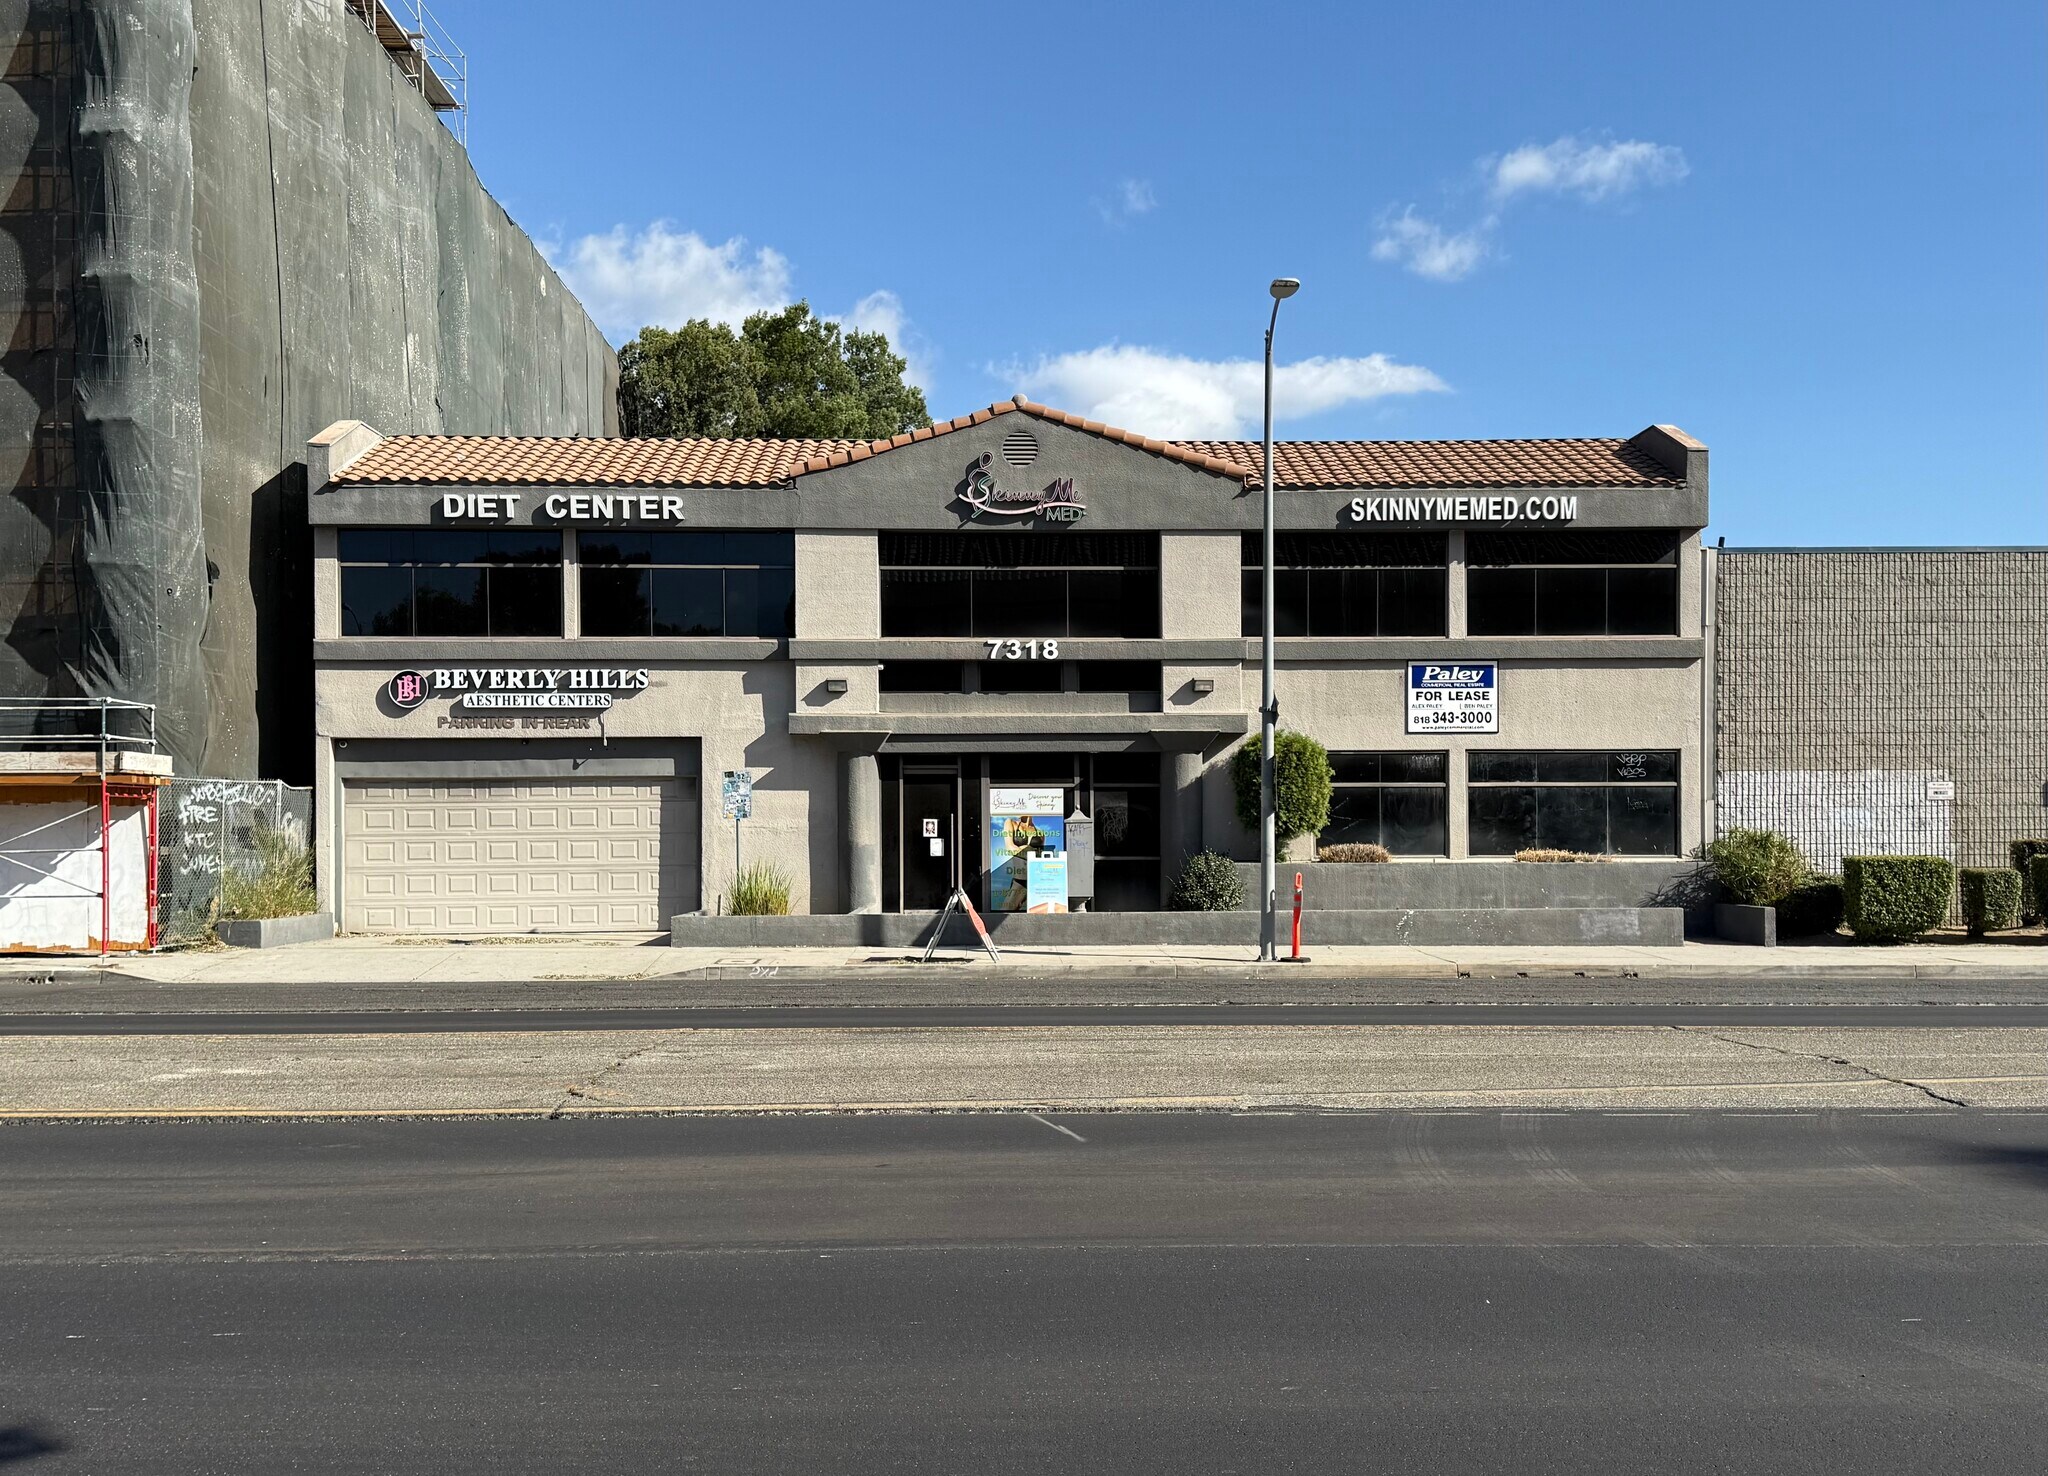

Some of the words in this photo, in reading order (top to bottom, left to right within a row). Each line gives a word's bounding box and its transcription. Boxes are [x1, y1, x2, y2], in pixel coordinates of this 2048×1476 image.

[443, 493, 520, 518] DIET
[545, 494, 685, 520] CENTER
[1045, 506, 1083, 522] MED
[1350, 496, 1578, 522] SKINNYMEMED.COM
[987, 639, 1059, 660] 7318
[433, 668, 561, 690] BEVERLY
[567, 668, 649, 690] HILLS
[1422, 666, 1485, 683] Paley
[466, 694, 545, 707] AESTHETIC
[548, 694, 611, 707] CENTERS
[1416, 691, 1442, 701] FOR
[1448, 691, 1490, 701] LEASE
[437, 716, 515, 730] PARKING
[542, 716, 590, 730] REAR
[1413, 716, 1430, 724] 818
[1432, 711, 1492, 723] 343-3000
[992, 829, 1012, 837] Diet
[1014, 829, 1061, 839] Injections
